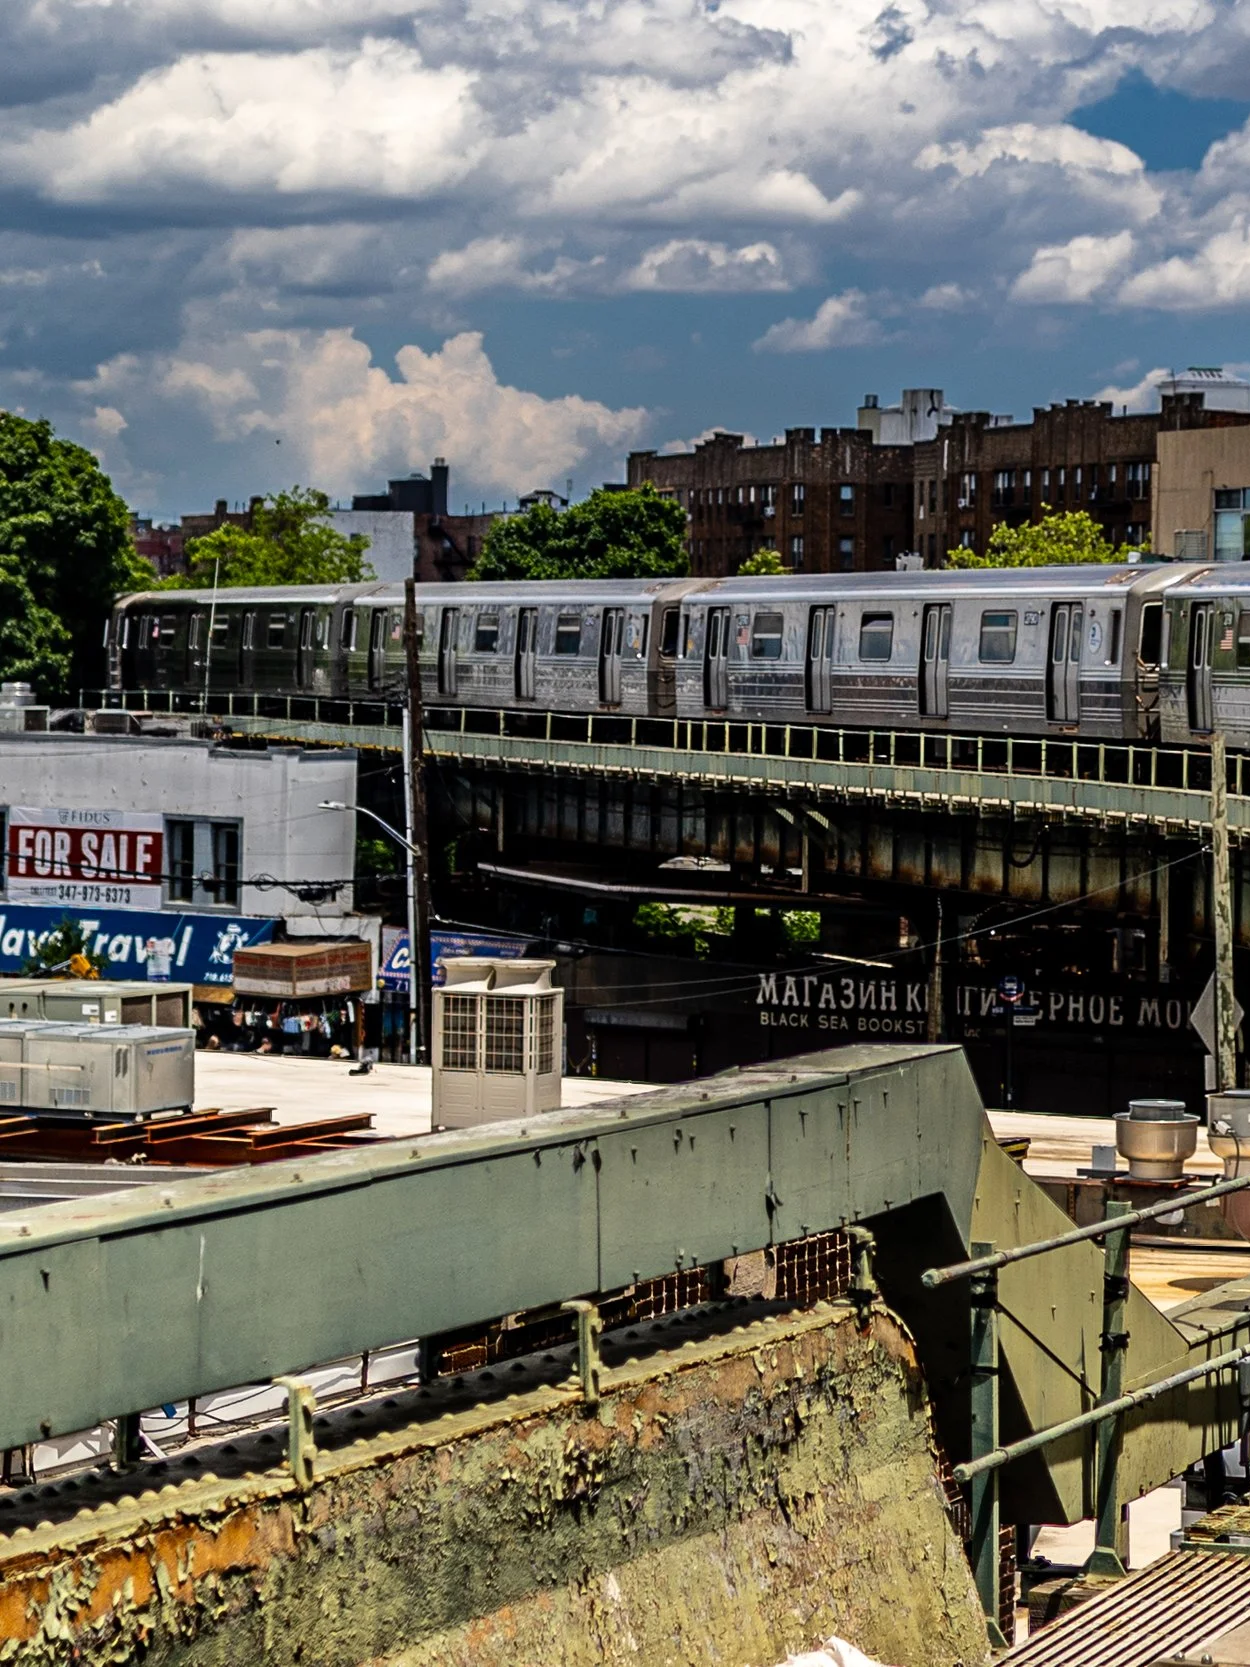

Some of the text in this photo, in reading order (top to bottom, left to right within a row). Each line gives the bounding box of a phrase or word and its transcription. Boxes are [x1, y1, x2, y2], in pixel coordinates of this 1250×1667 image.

[71, 810, 110, 823] FIDUS
[18, 829, 153, 881] FOR SALE
[760, 1012, 808, 1028] BLACK
[818, 1014, 849, 1030] SEA
[1012, 990, 1124, 1026] ЕРНОЕ
